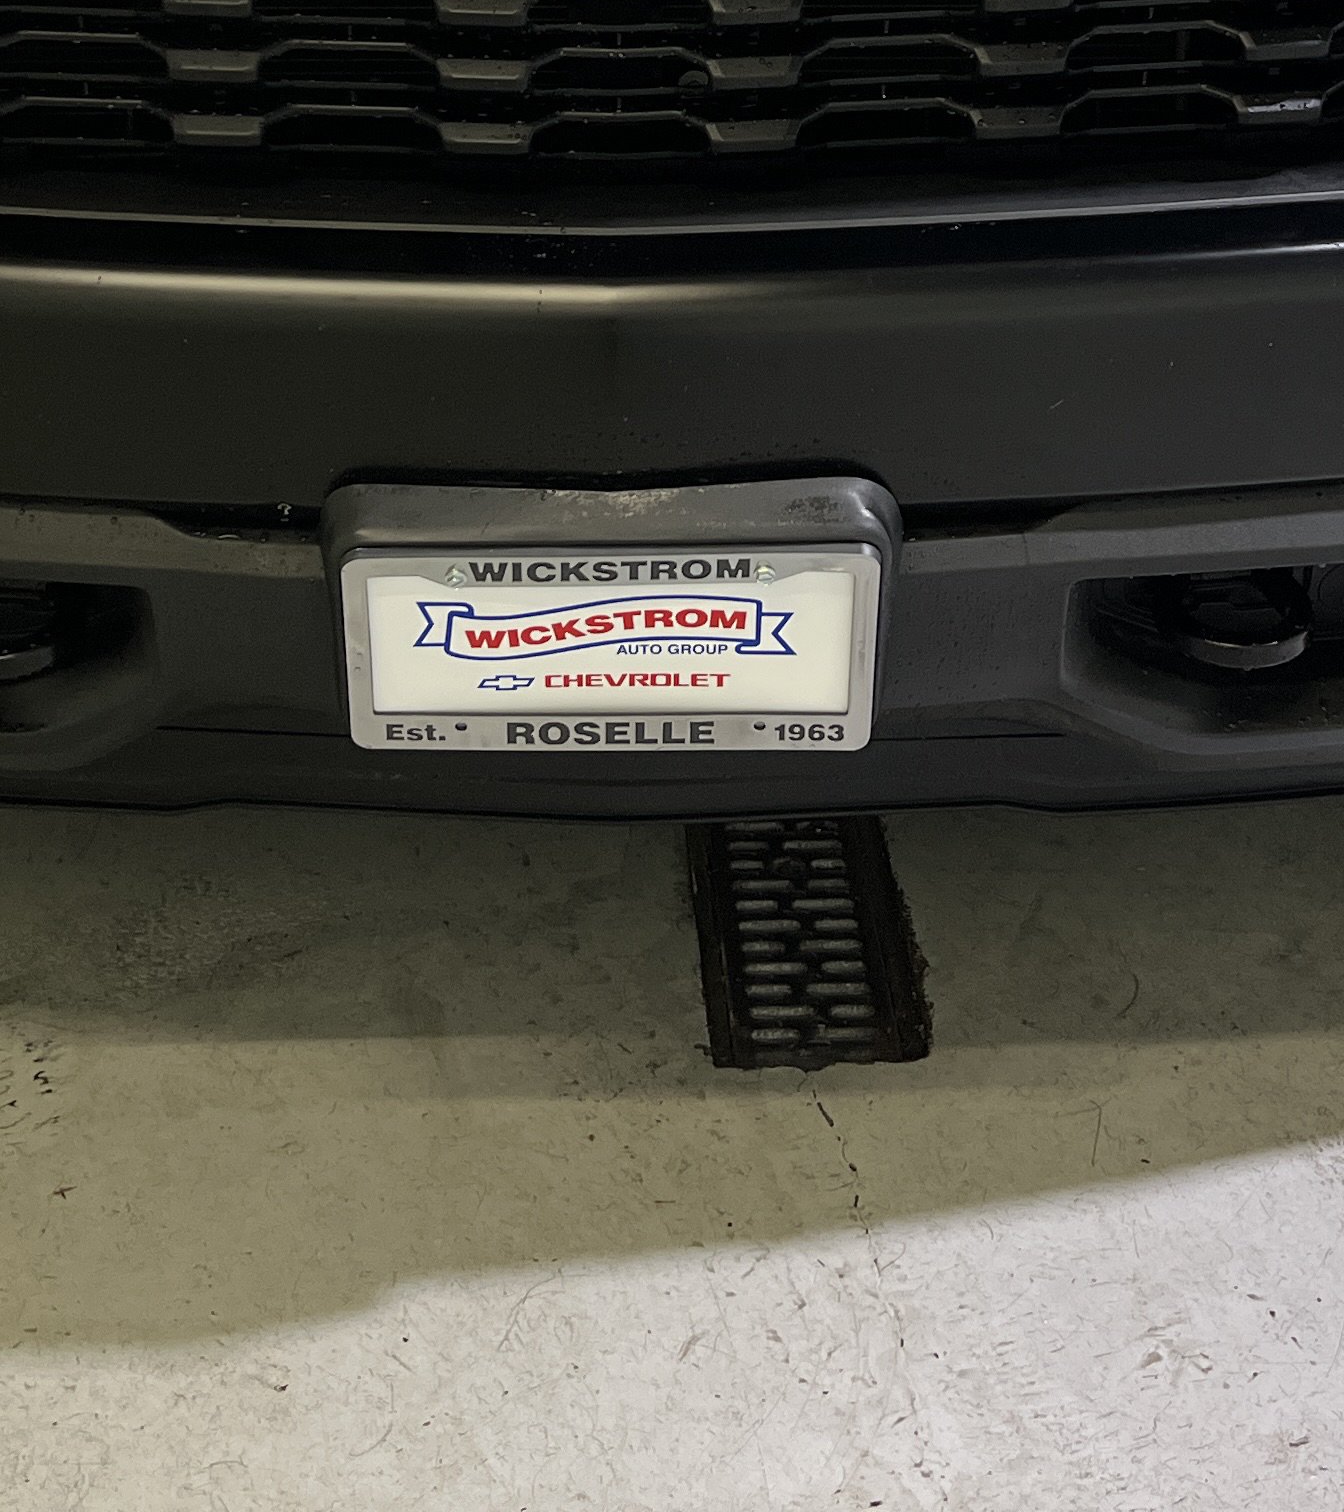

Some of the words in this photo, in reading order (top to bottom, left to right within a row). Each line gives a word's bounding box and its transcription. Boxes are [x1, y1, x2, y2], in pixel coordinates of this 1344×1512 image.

[468, 558, 751, 583] WICKSTROM
[464, 607, 747, 649] WICKSTROM
[616, 644, 663, 656] AUTO
[667, 643, 728, 656] GROUP
[544, 673, 731, 688] CHEVROLET
[385, 723, 447, 741] Est.
[506, 720, 716, 744] ROSELLE
[774, 723, 845, 742] 1963
